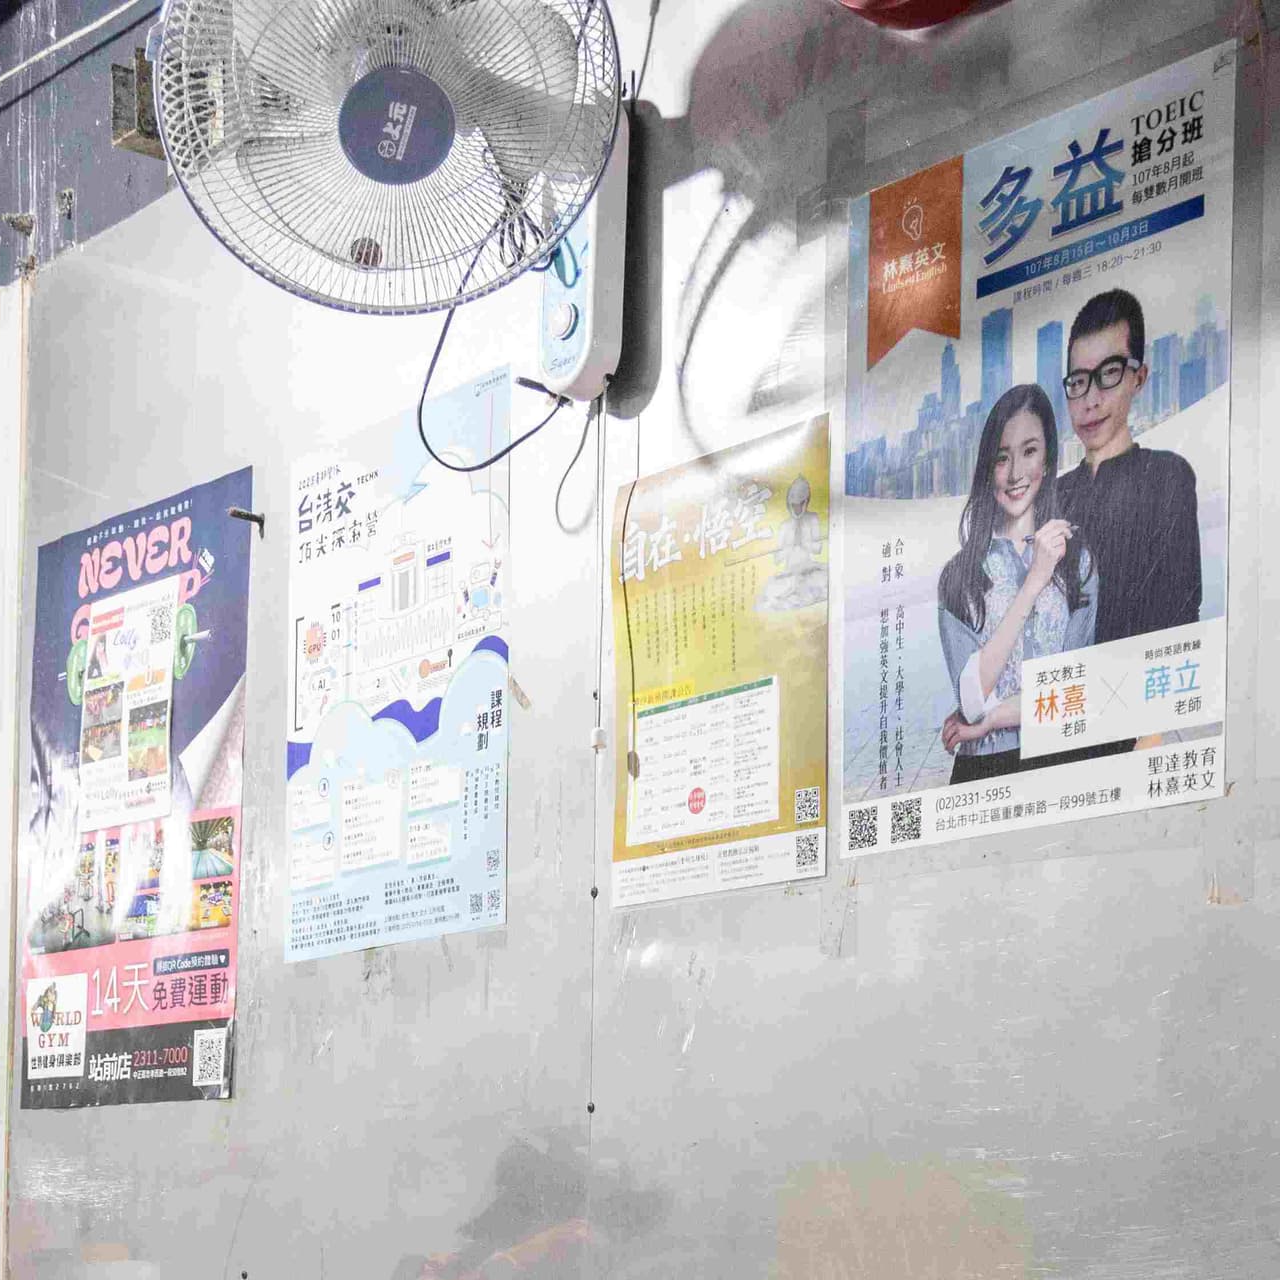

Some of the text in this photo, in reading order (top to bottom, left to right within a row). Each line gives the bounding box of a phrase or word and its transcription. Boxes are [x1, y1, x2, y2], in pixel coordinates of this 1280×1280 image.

[1131, 89, 1205, 138] TOEIC
[1131, 115, 1204, 167] 搶分班
[1131, 167, 1205, 206] 每雙數月開班
[1132, 150, 1195, 187] 107年8月起
[977, 127, 1125, 267] 多益
[78, 517, 192, 599] NEVER
[1144, 639, 1202, 661] 時尚英語教練
[1036, 662, 1087, 686] 英文教主
[1144, 659, 1201, 703] 薛立
[1034, 683, 1088, 724] 林熹
[1174, 696, 1202, 716] 老師
[1061, 719, 1087, 738] 老師
[1147, 746, 1217, 776] 聖達教育
[935, 786, 1012, 814] (02)2331-5955
[1147, 769, 1216, 799] 林熹英文
[935, 787, 1122, 833] 台北市中正區重慶南路一段99號五樓
[92, 963, 149, 1016] 14天
[152, 972, 229, 1011] 免費運動
[38, 1033, 70, 1048] GYM
[133, 1046, 188, 1067] 2311-7000
[88, 1052, 132, 1081] 站前店
